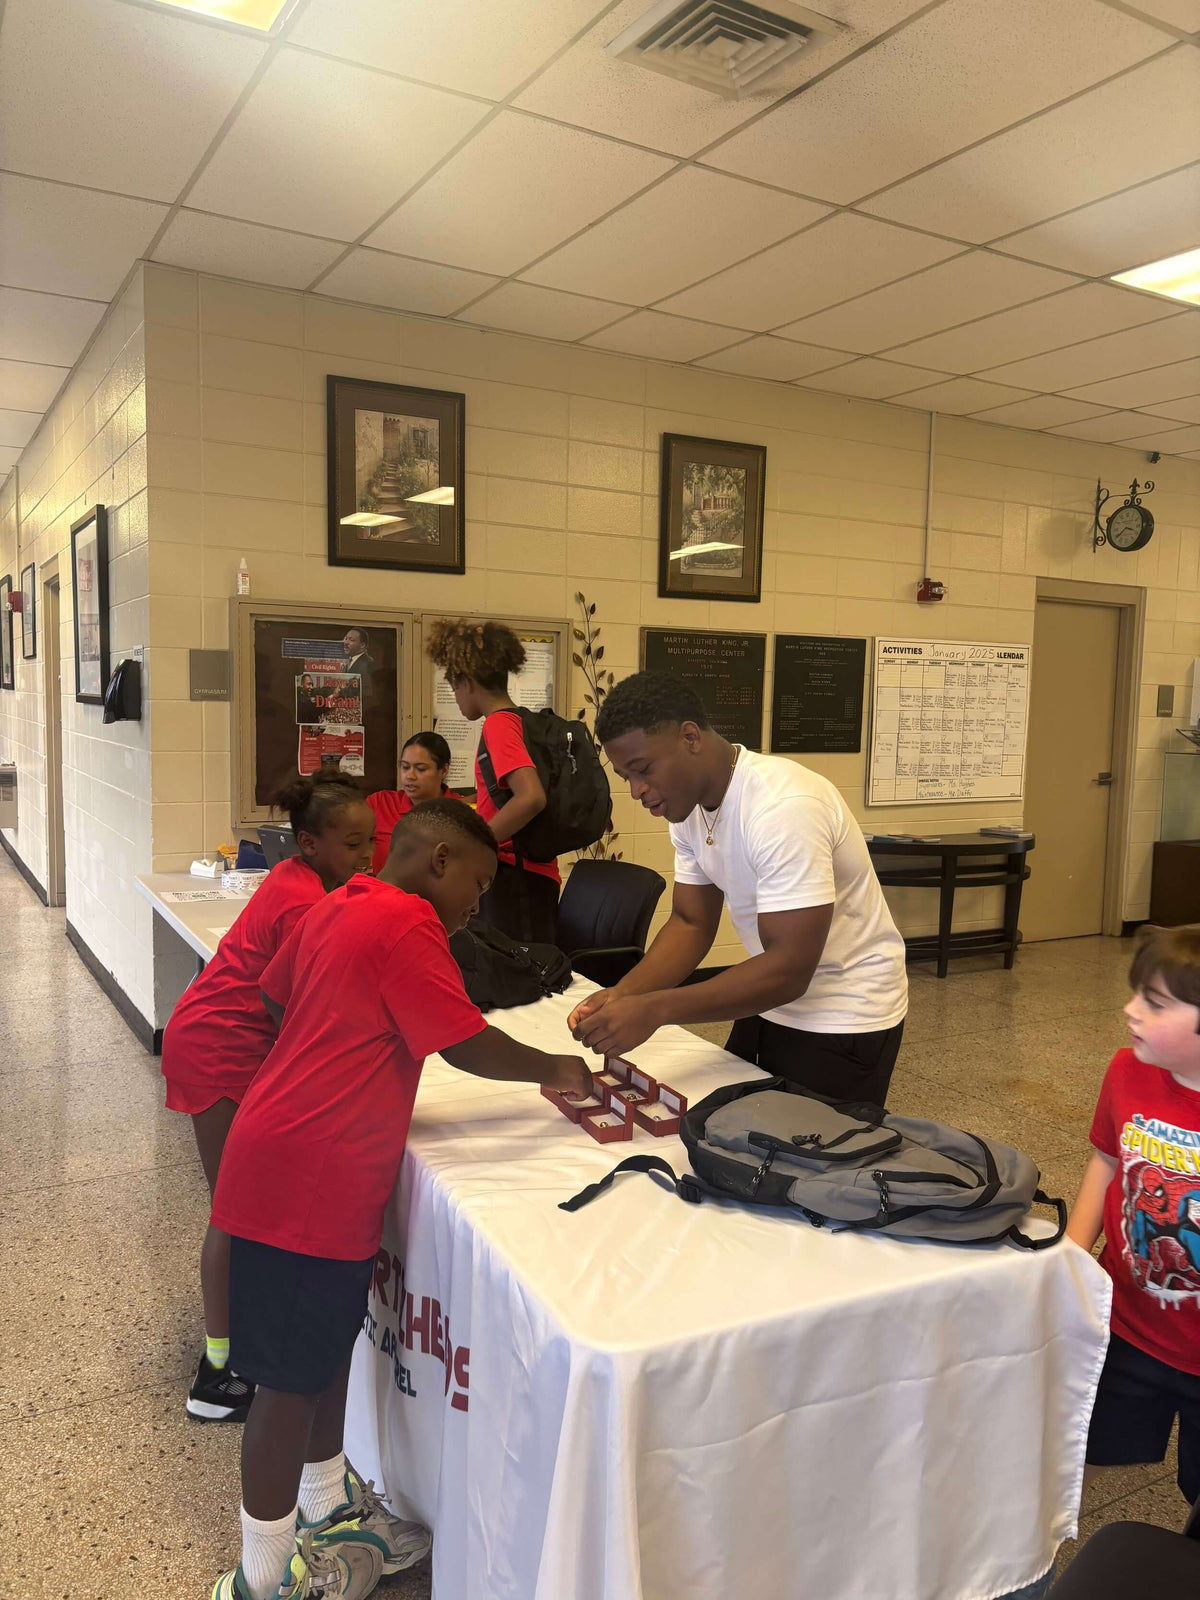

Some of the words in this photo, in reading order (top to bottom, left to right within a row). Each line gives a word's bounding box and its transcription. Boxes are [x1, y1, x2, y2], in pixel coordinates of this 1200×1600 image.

[663, 636, 689, 644] MARTIN
[693, 638, 718, 646] LUTHER
[721, 639, 739, 648] KING,
[667, 647, 716, 656] MULTIPURPOSE
[720, 649, 745, 657] CENTER
[882, 646, 923, 656] ACTIVITIES
[927, 644, 967, 660] January
[968, 647, 995, 660] 2025
[316, 676, 321, 688] I
[324, 676, 349, 688] Have
[352, 678, 359, 688] a
[315, 694, 360, 708] Dream!
